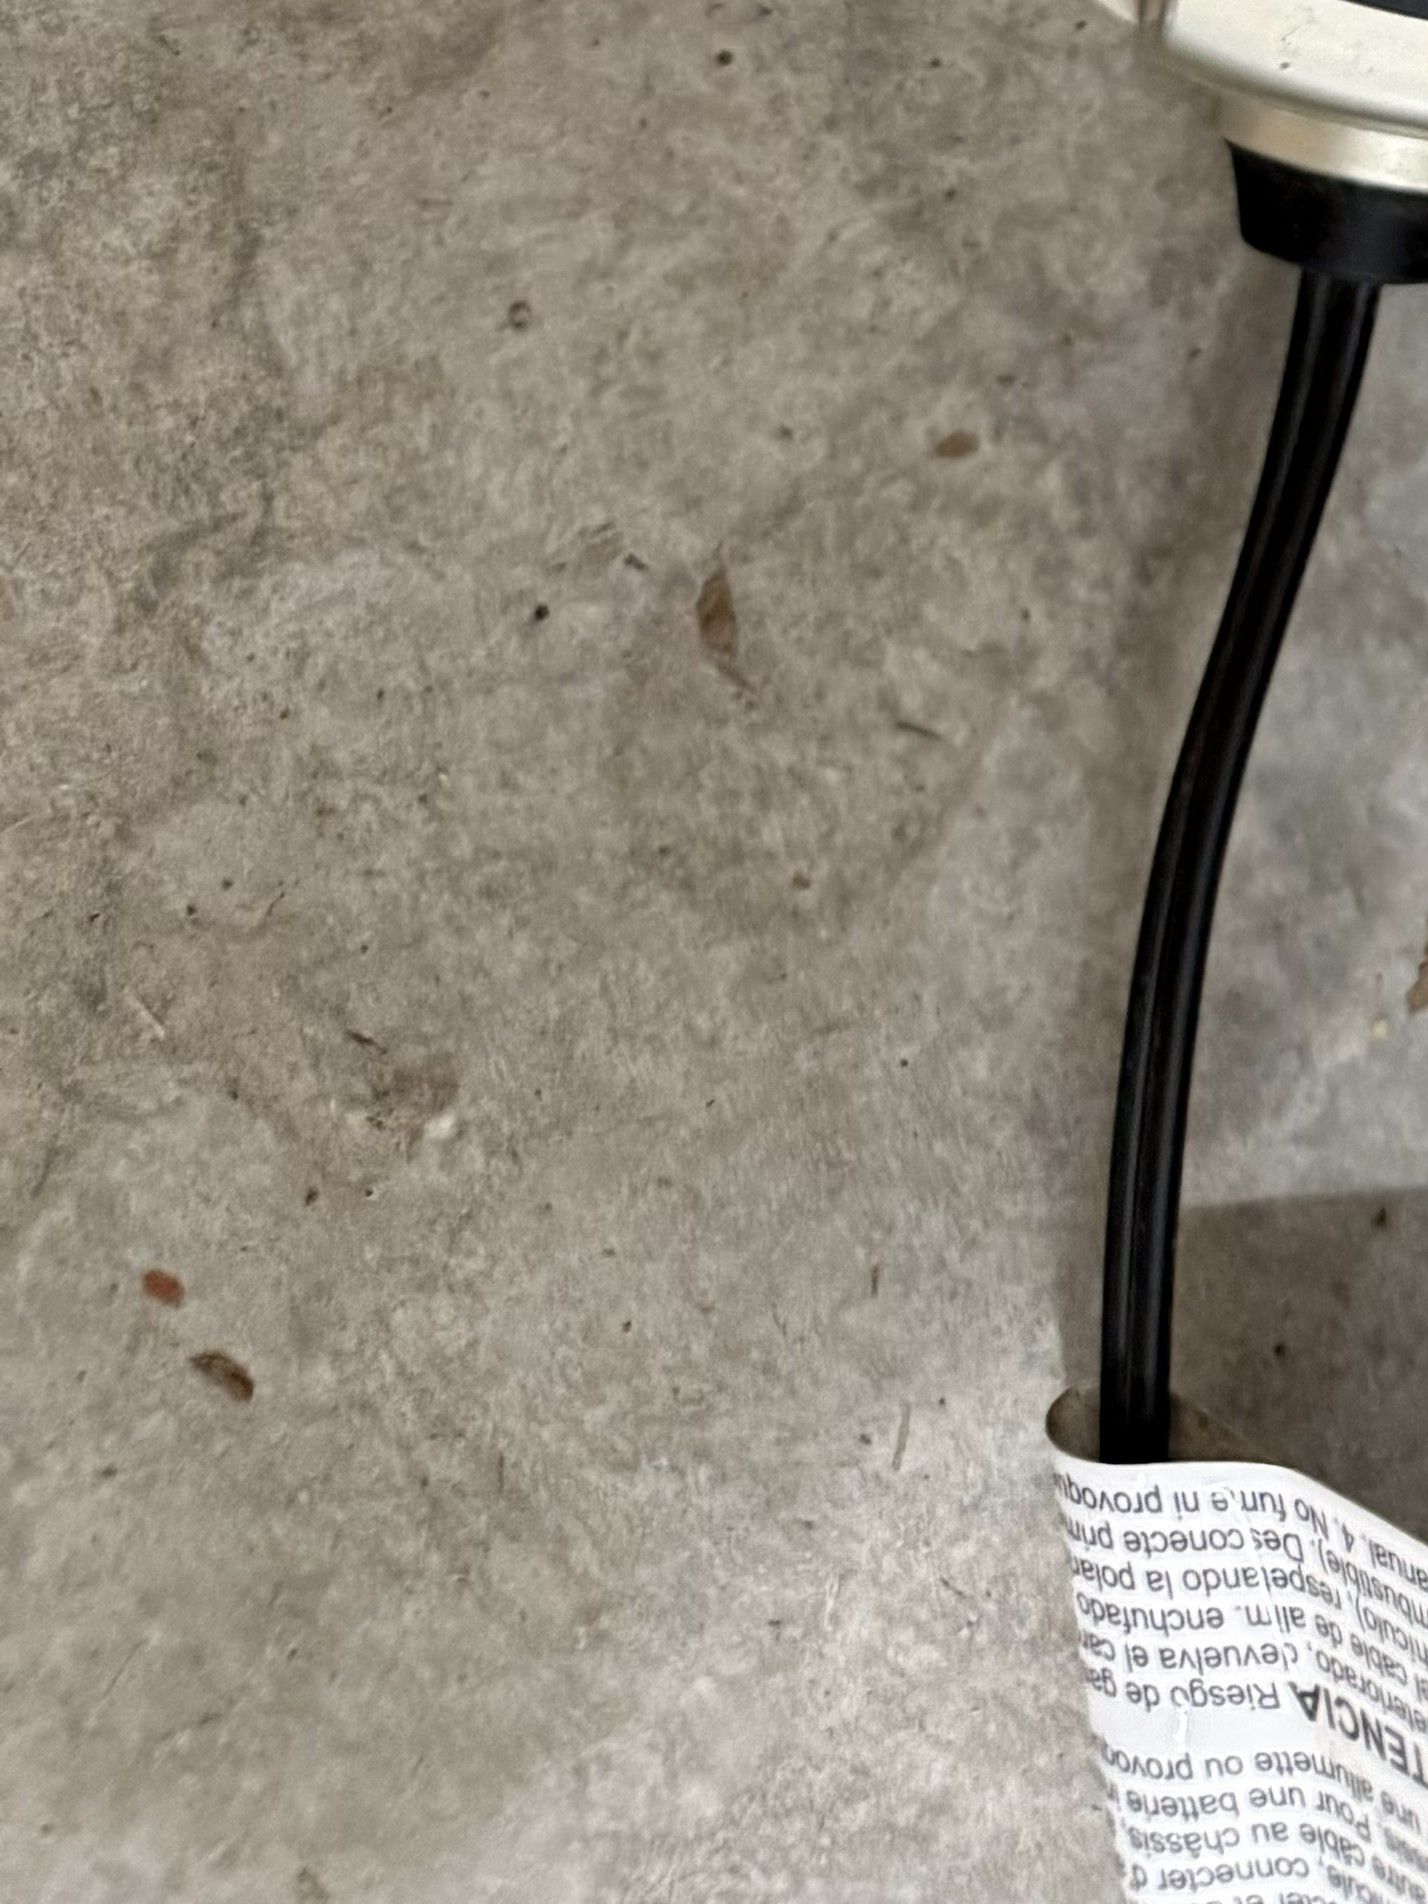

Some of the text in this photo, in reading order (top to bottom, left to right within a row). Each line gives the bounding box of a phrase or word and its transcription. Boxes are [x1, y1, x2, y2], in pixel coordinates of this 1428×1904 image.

[1174, 1492, 1200, 1520] ni
[1294, 1499, 1328, 1541] No
[1123, 1527, 1303, 1563] Desconecte
[1332, 1517, 1354, 1552] 4.
[1146, 1570, 1173, 1600] la
[1182, 1562, 1342, 1612] respetando
[1077, 1593, 1224, 1637] enchufado
[1235, 1604, 1307, 1634] alim.
[1315, 1615, 1342, 1652] de
[1125, 1644, 1149, 1674] el
[1159, 1642, 1299, 1675] devuelva
[1351, 1634, 1407, 1686] cable
[1125, 1683, 1161, 1712] de
[1169, 1678, 1280, 1711] Riesgo
[1205, 1755, 1244, 1779] ou
[1253, 1751, 1374, 1802] allumette
[1127, 1789, 1239, 1822] batterie
[1248, 1786, 1306, 1807] une
[1251, 1822, 1289, 1844] au
[1315, 1791, 1371, 1844] Pour
[1299, 1823, 1365, 1871] câble
[1157, 1857, 1309, 1892] connecter
